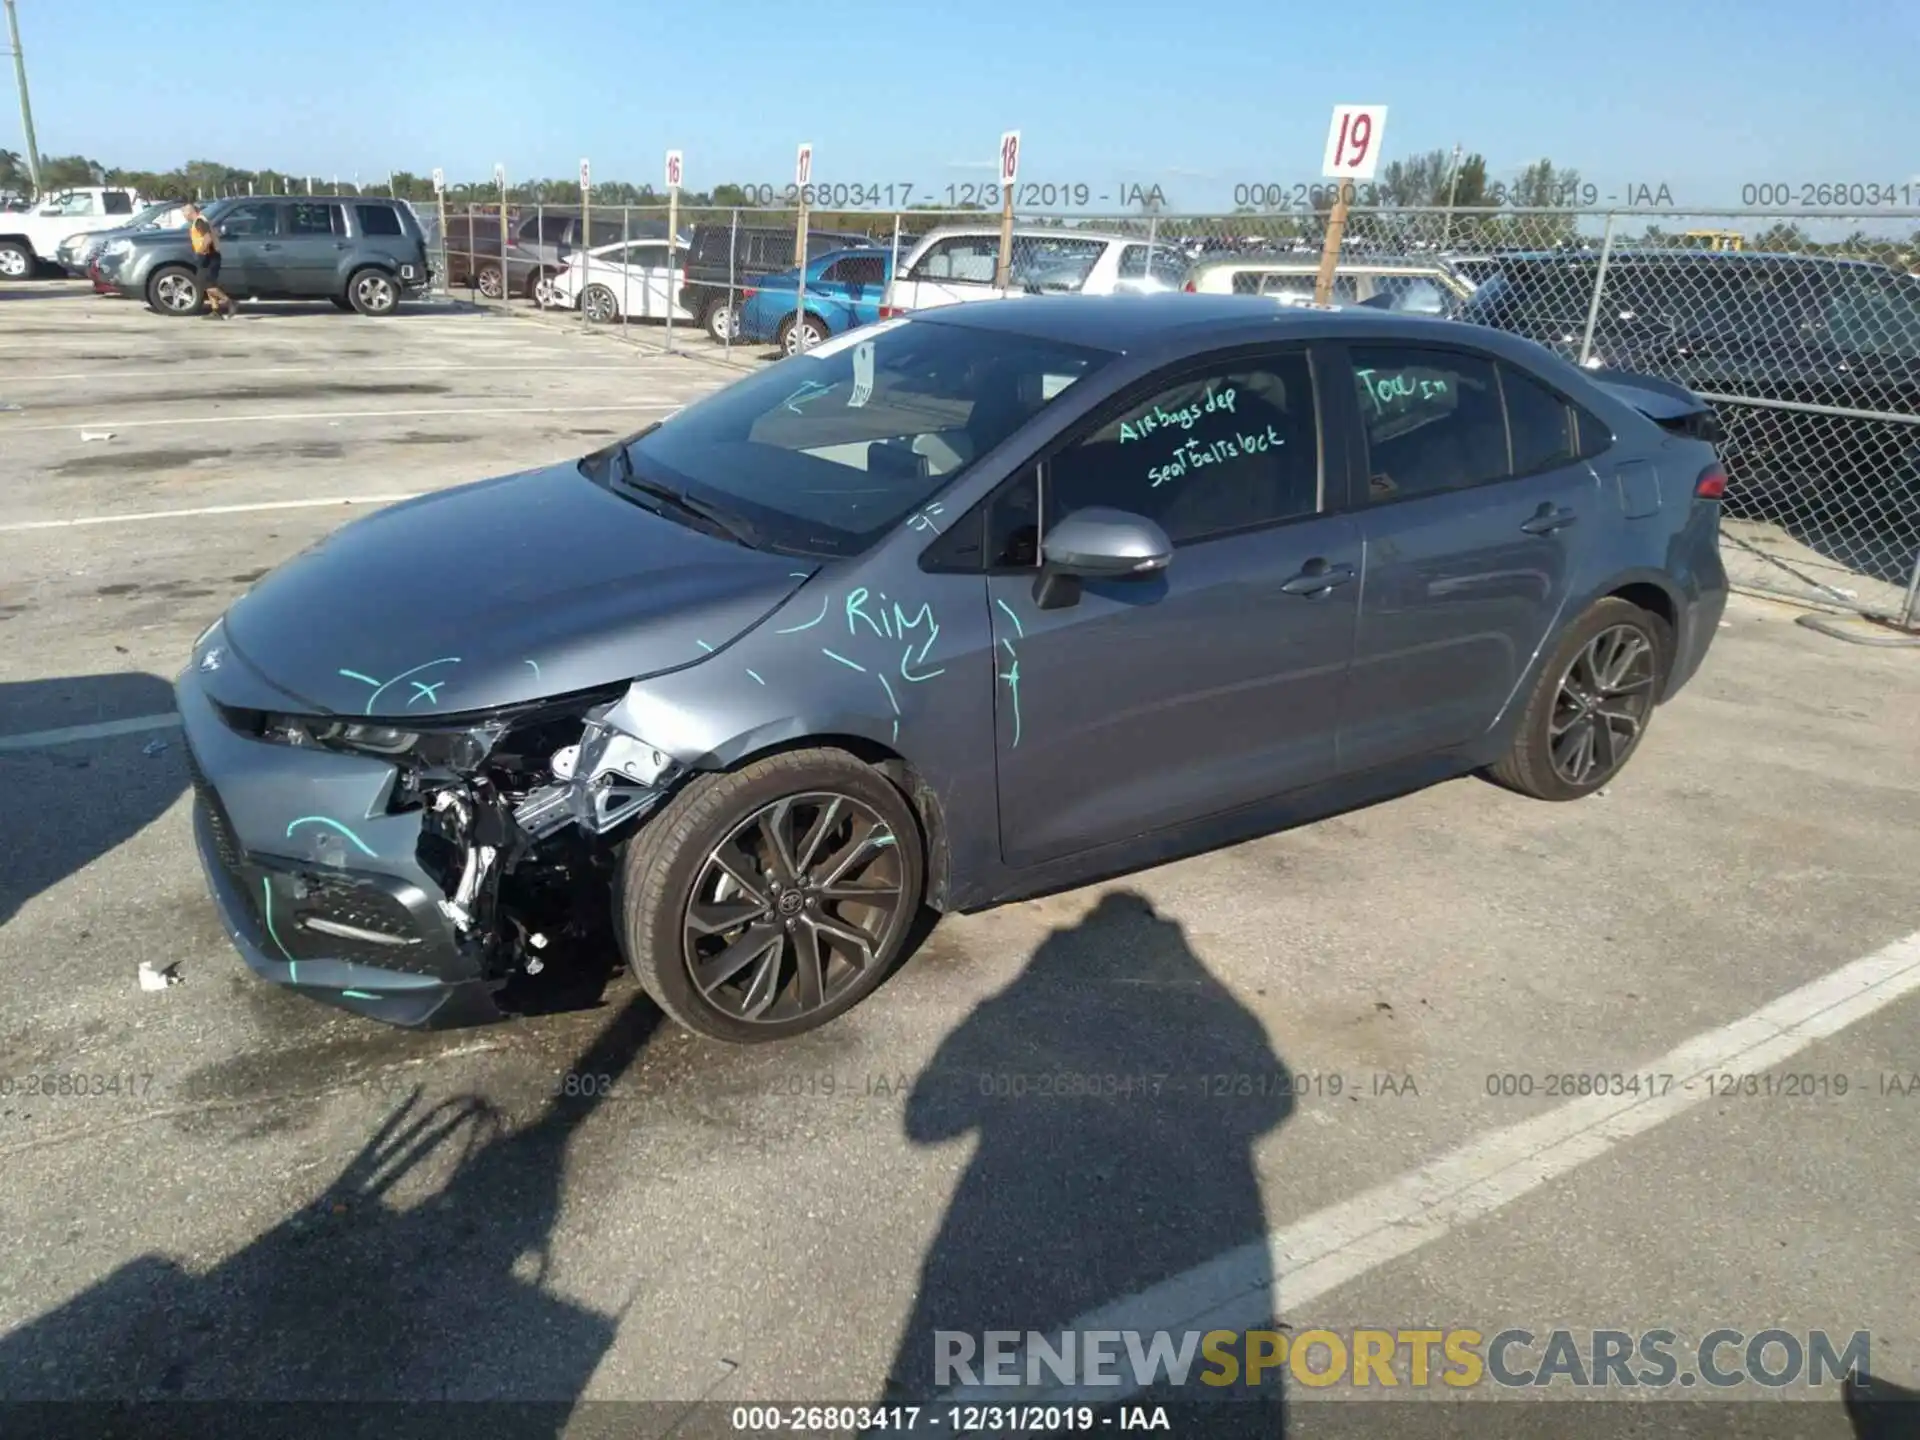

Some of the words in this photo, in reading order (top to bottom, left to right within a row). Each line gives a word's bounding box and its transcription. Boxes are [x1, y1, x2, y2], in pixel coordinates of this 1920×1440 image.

[1002, 135, 1018, 178] 18
[1335, 113, 1372, 167] 19
[666, 156, 681, 184] 16
[799, 149, 811, 182] 17
[1205, 386, 1236, 413] dep
